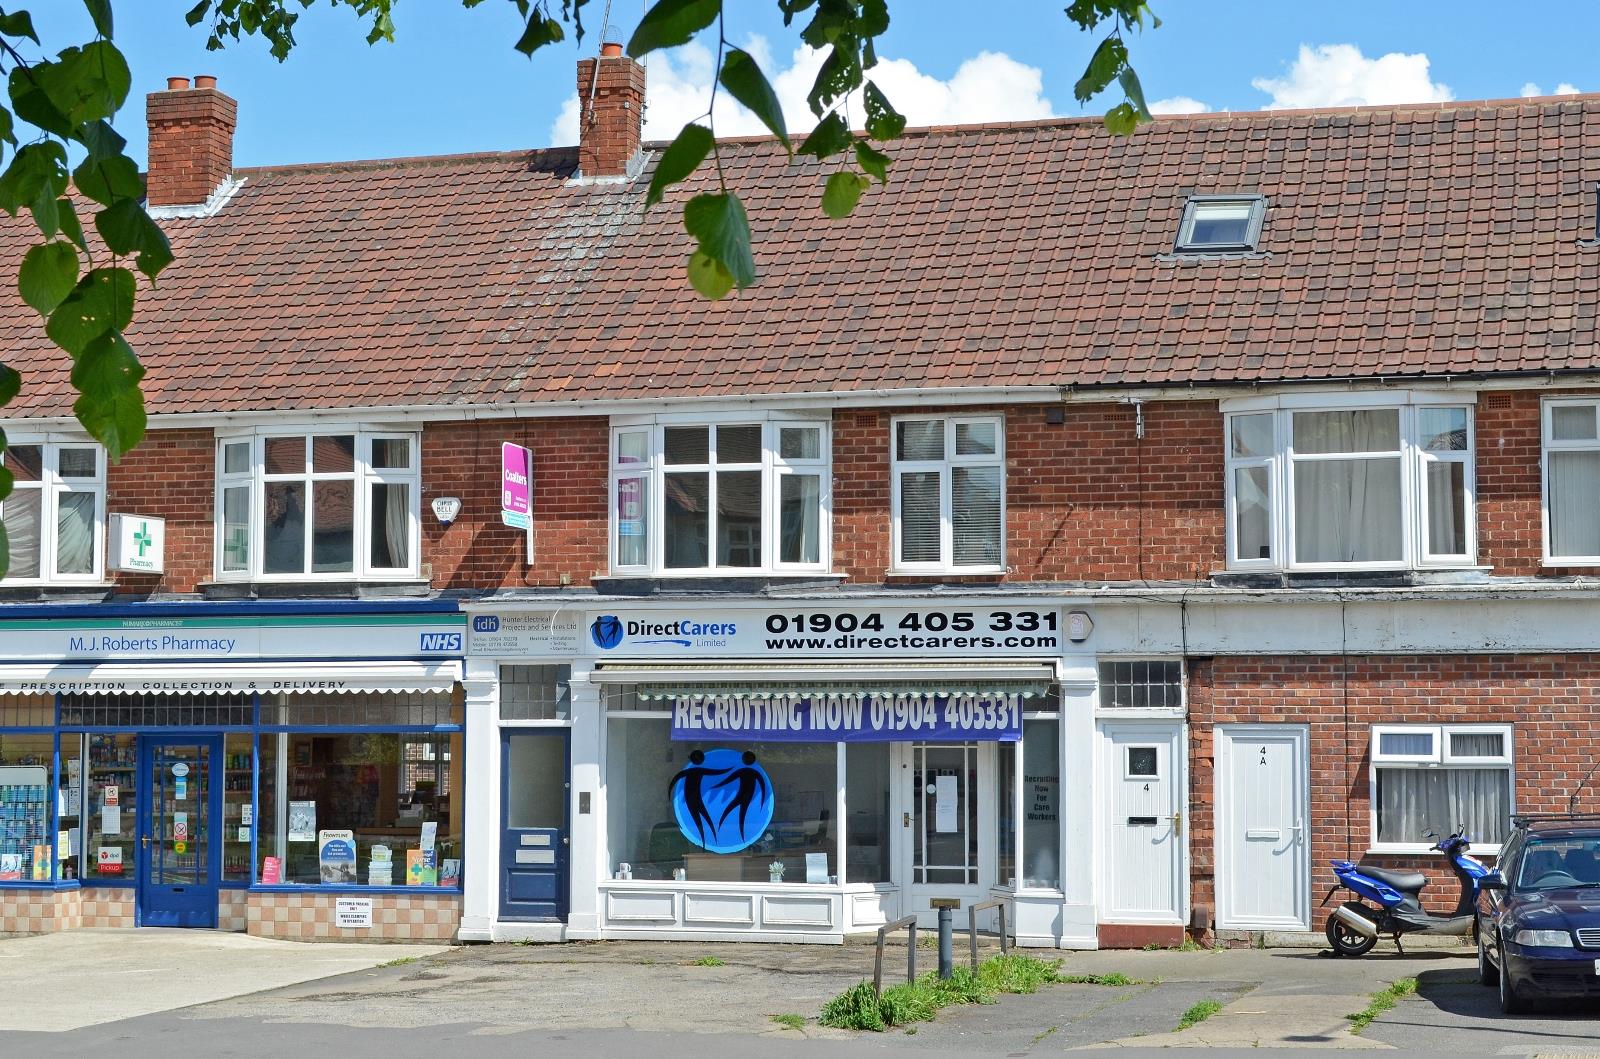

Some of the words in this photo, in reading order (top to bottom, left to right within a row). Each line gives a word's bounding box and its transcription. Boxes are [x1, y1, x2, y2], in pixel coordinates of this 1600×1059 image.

[567, 622, 577, 630] Ltd
[765, 613, 884, 633] 01904
[899, 612, 975, 632] 405
[989, 611, 1057, 631] 331
[627, 620, 737, 636] DirectCarers
[70, 637, 87, 651] M.
[89, 636, 99, 651] J.
[102, 636, 158, 651] Roberts
[162, 635, 236, 653] Pharmacy
[422, 634, 460, 650] NHS
[696, 638, 726, 647] Limited
[765, 634, 1057, 649] www.directcarers.com
[20, 682, 126, 690] PRESCRIPTION
[142, 682, 233, 690] COLLECTION
[248, 681, 257, 689] &
[273, 681, 346, 689] DELIVERY
[674, 697, 802, 730] RECRUITING
[809, 697, 864, 730] NOW
[870, 696, 937, 730] 01904
[944, 696, 1020, 729] 405331
[1260, 746, 1267, 755] 4
[1260, 757, 1267, 765] A
[1024, 775, 1059, 783] Recruiting
[1143, 783, 1150, 791] 4
[1034, 803, 1050, 811] Care
[1027, 812, 1057, 821] Workers
[100, 864, 120, 872] Pickup
